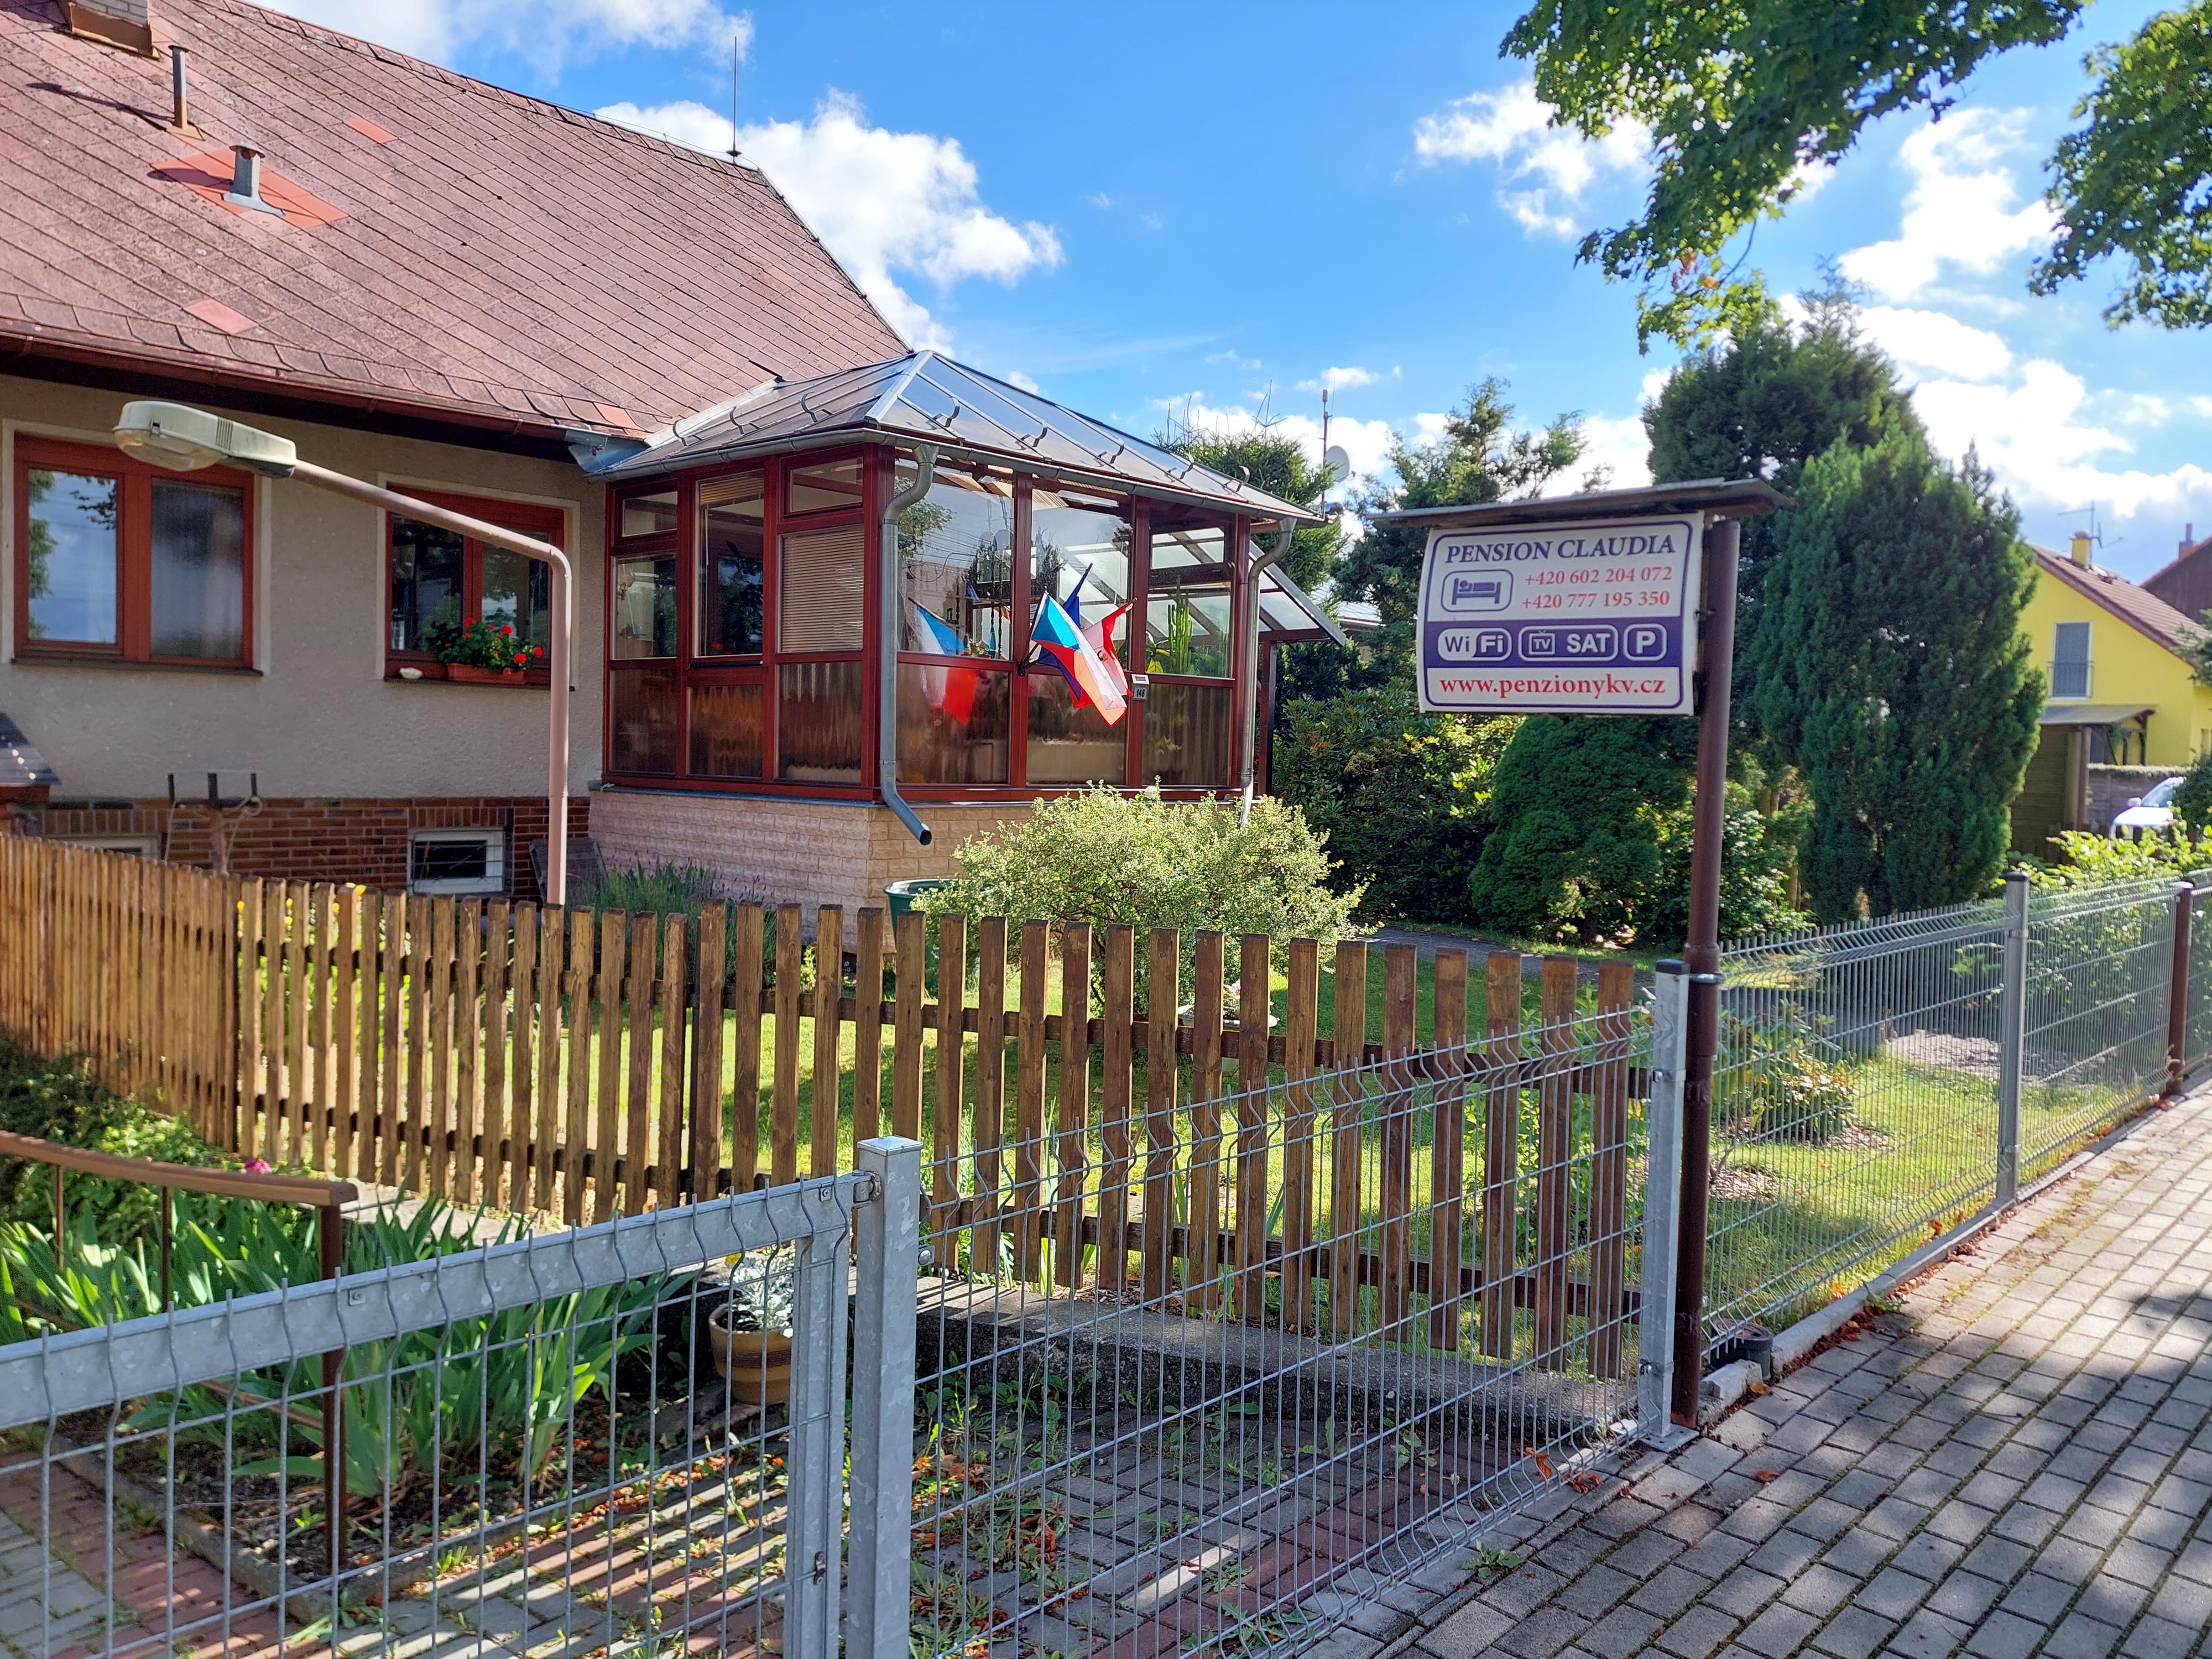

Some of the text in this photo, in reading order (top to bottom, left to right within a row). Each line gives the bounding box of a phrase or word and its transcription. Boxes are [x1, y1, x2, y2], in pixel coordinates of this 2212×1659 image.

[1445, 534, 1676, 564] PENSION CLAUDIA
[1525, 566, 1672, 585] +420 602 204 072
[1522, 591, 1670, 609] +420 777 195 350
[1533, 633, 1610, 653] TV SAT
[1636, 632, 1656, 654] P
[1136, 688, 1145, 697] 146
[1439, 674, 1665, 699] www.penzionykv.cz
